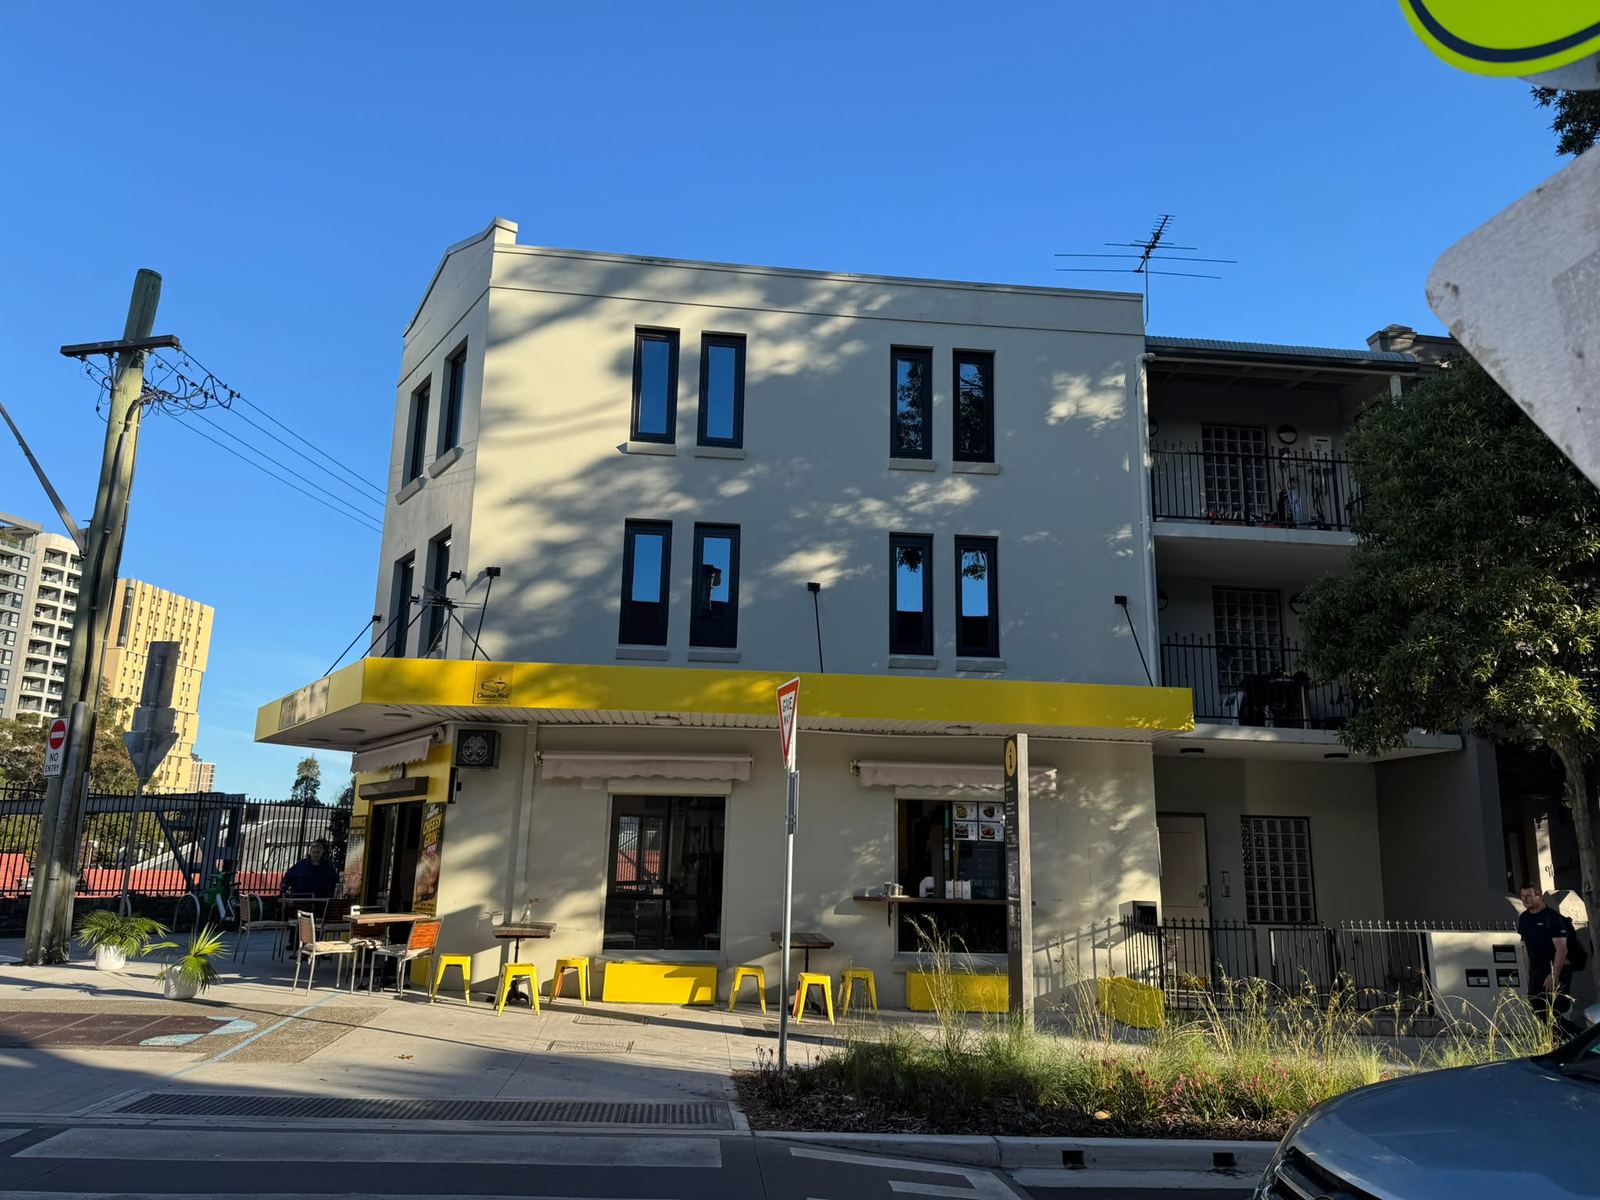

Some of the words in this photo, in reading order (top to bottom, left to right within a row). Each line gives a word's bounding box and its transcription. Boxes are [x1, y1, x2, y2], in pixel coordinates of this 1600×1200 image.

[782, 695, 793, 712] GIVE
[49, 752, 58, 762] NO
[44, 764, 60, 773] ENTRY
